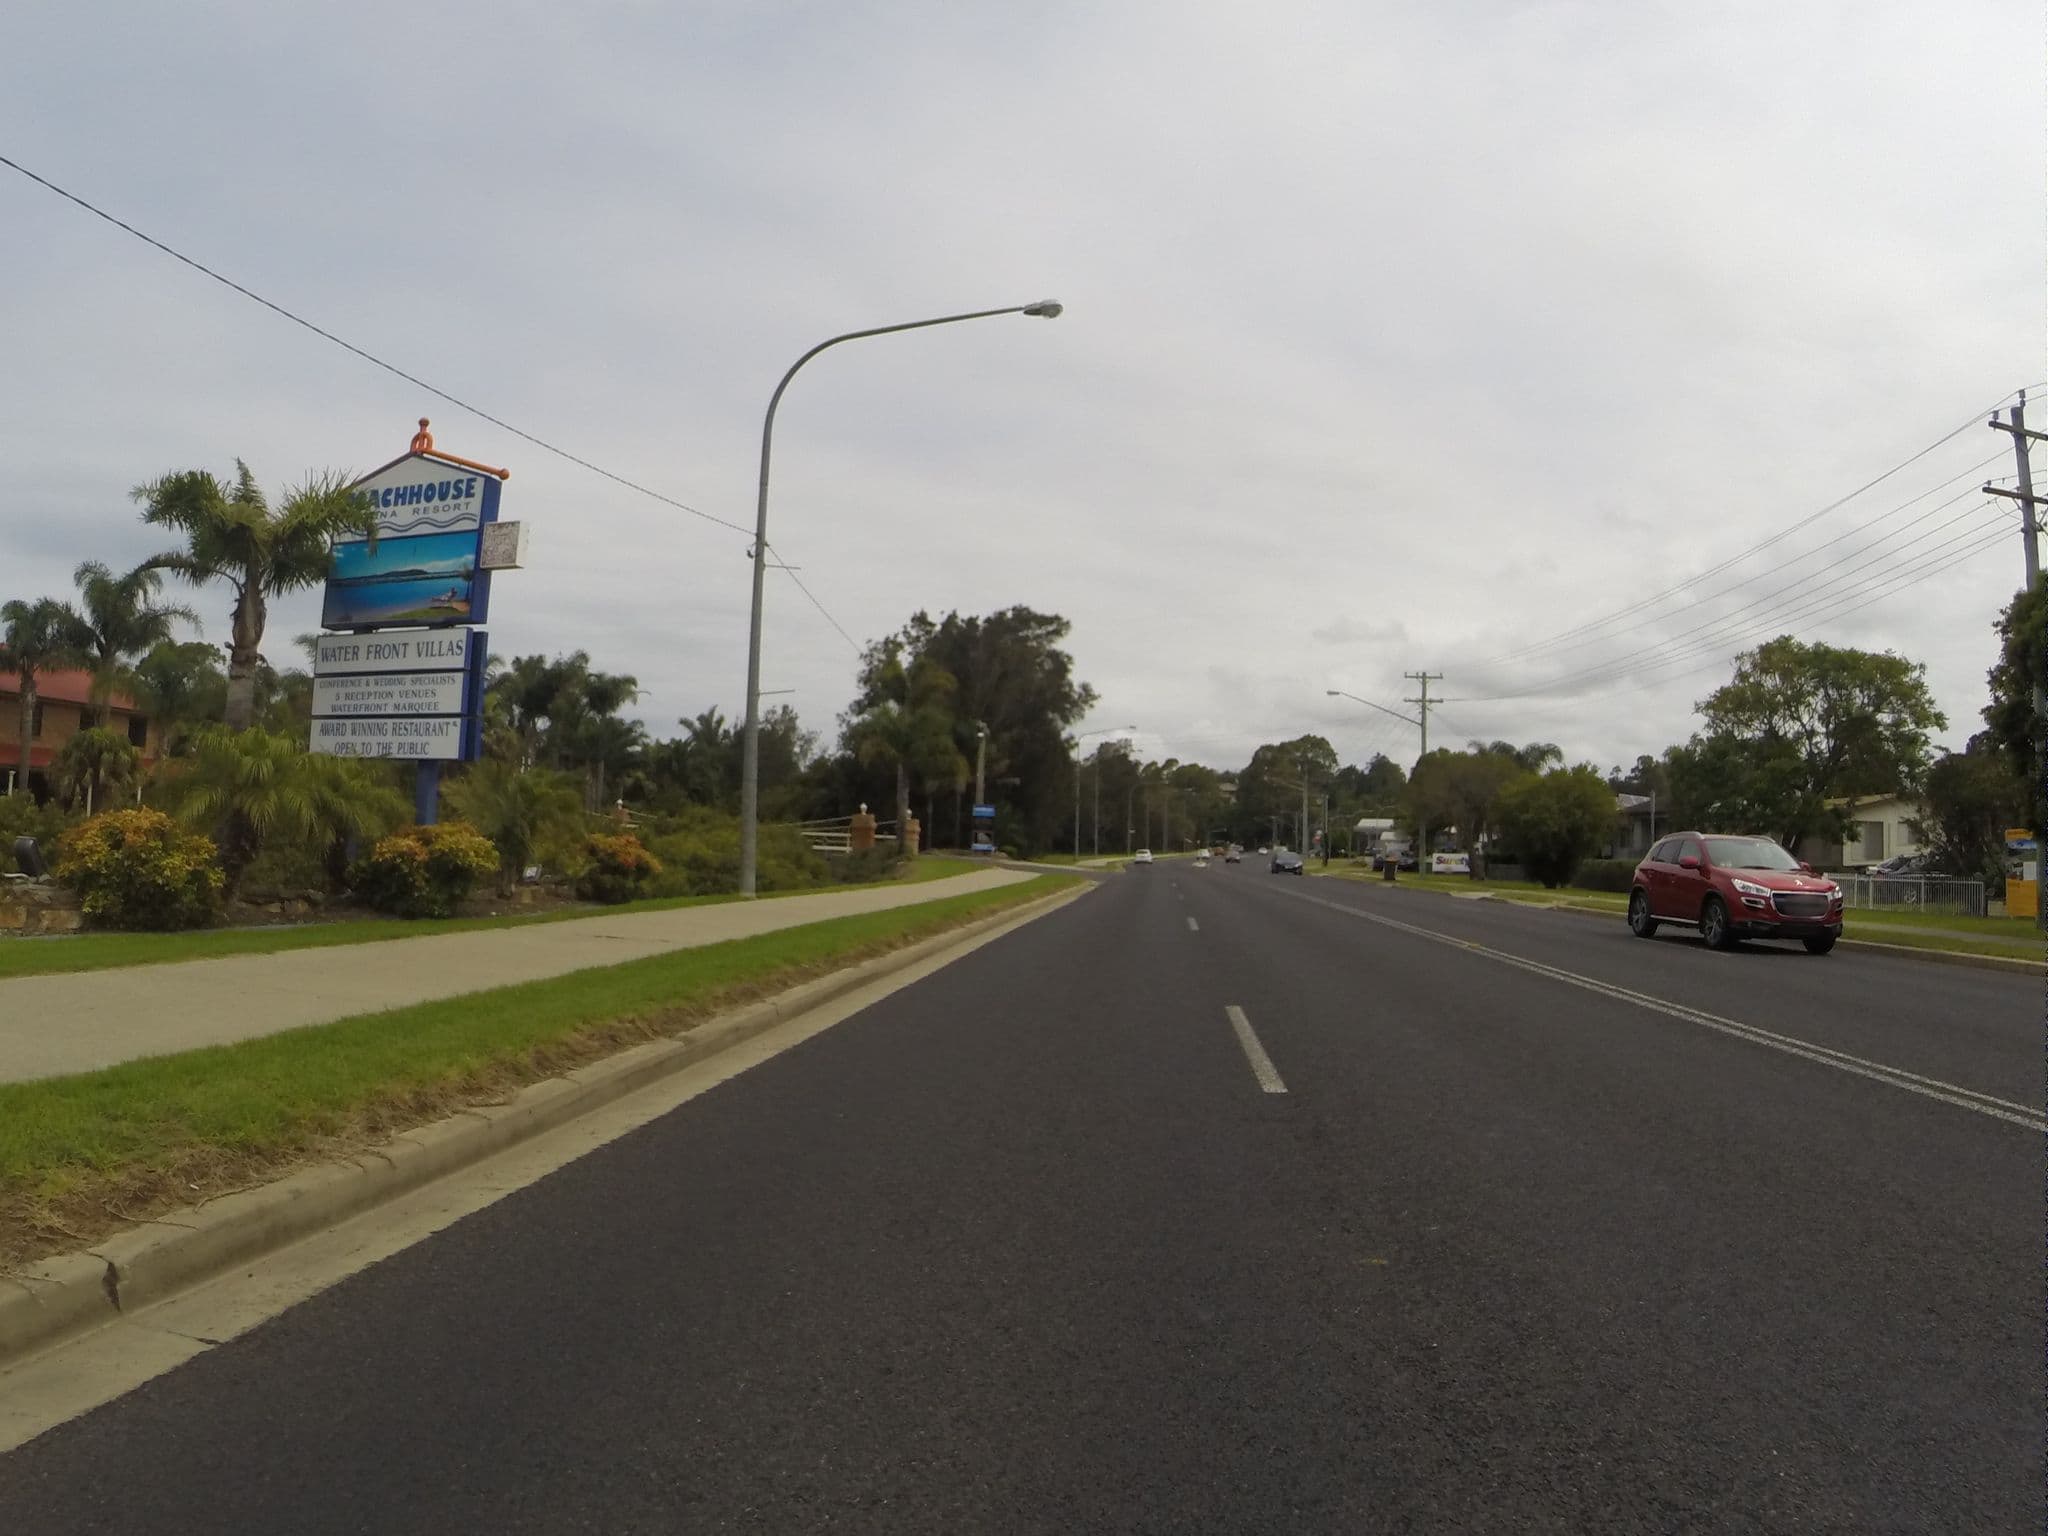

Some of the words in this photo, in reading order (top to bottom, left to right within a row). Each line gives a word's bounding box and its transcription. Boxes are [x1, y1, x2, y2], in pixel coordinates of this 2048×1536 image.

[350, 477, 477, 511] ACHHOUSE
[412, 501, 471, 516] RESORT
[321, 645, 360, 662] WATER
[366, 642, 409, 660] FRONT
[416, 639, 463, 657] VILLAS
[319, 678, 362, 689] CONFERENCE
[373, 676, 406, 687] WEDDING
[410, 675, 456, 686] SPECIALISTS
[344, 691, 394, 701] RECEPTION
[398, 689, 437, 699] VENUES
[331, 704, 388, 713] WATERFRONT
[393, 702, 440, 712] MARQUEE
[319, 722, 347, 737] AWARD
[351, 722, 388, 737] WINNING
[392, 721, 450, 737] RESTAURANT
[334, 742, 357, 755] OPEN
[361, 742, 372, 755] TO
[377, 742, 393, 755] THE
[397, 742, 430, 755] PUBLIC
